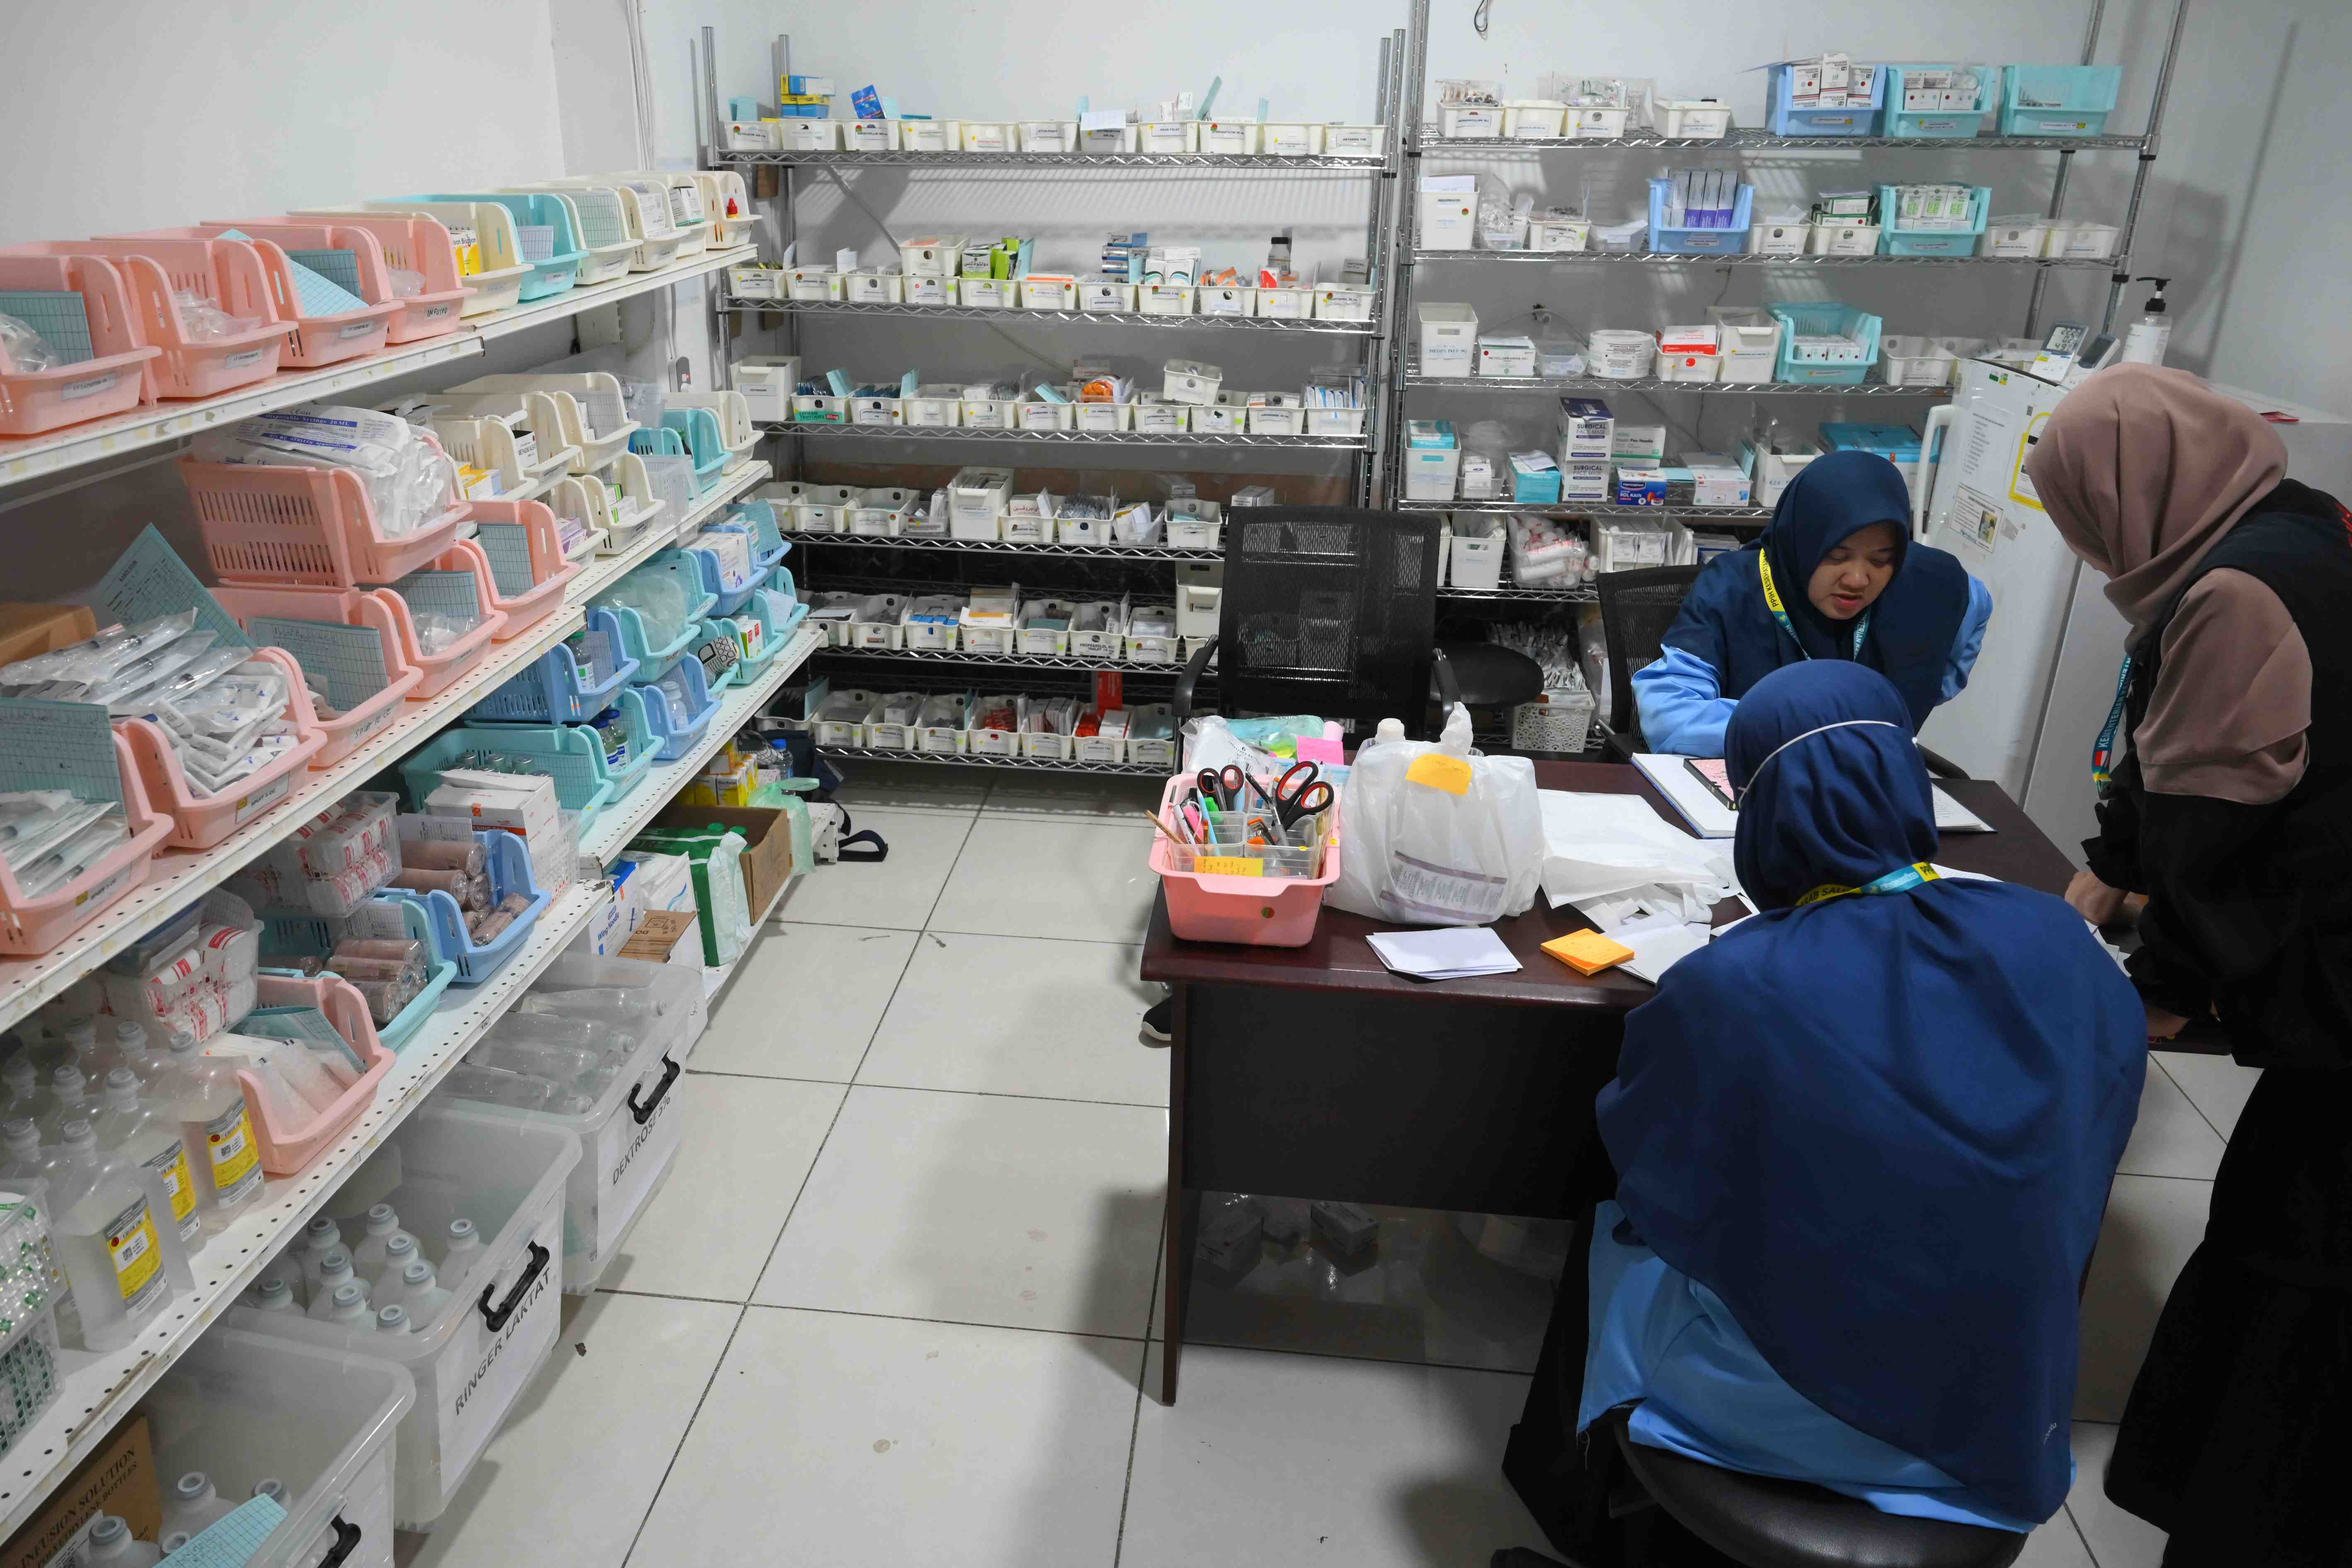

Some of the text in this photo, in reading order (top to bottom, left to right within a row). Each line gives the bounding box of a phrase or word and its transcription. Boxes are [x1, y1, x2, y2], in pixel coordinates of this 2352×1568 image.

[1767, 591, 1779, 608] PPIH
[597, 912, 620, 941] Wing Needle
[612, 1095, 671, 1185] DEXTROSE 5%
[455, 1267, 552, 1415] RINGER LAKTAT
[21, 1448, 136, 1568] INFUSION SOLUTION
